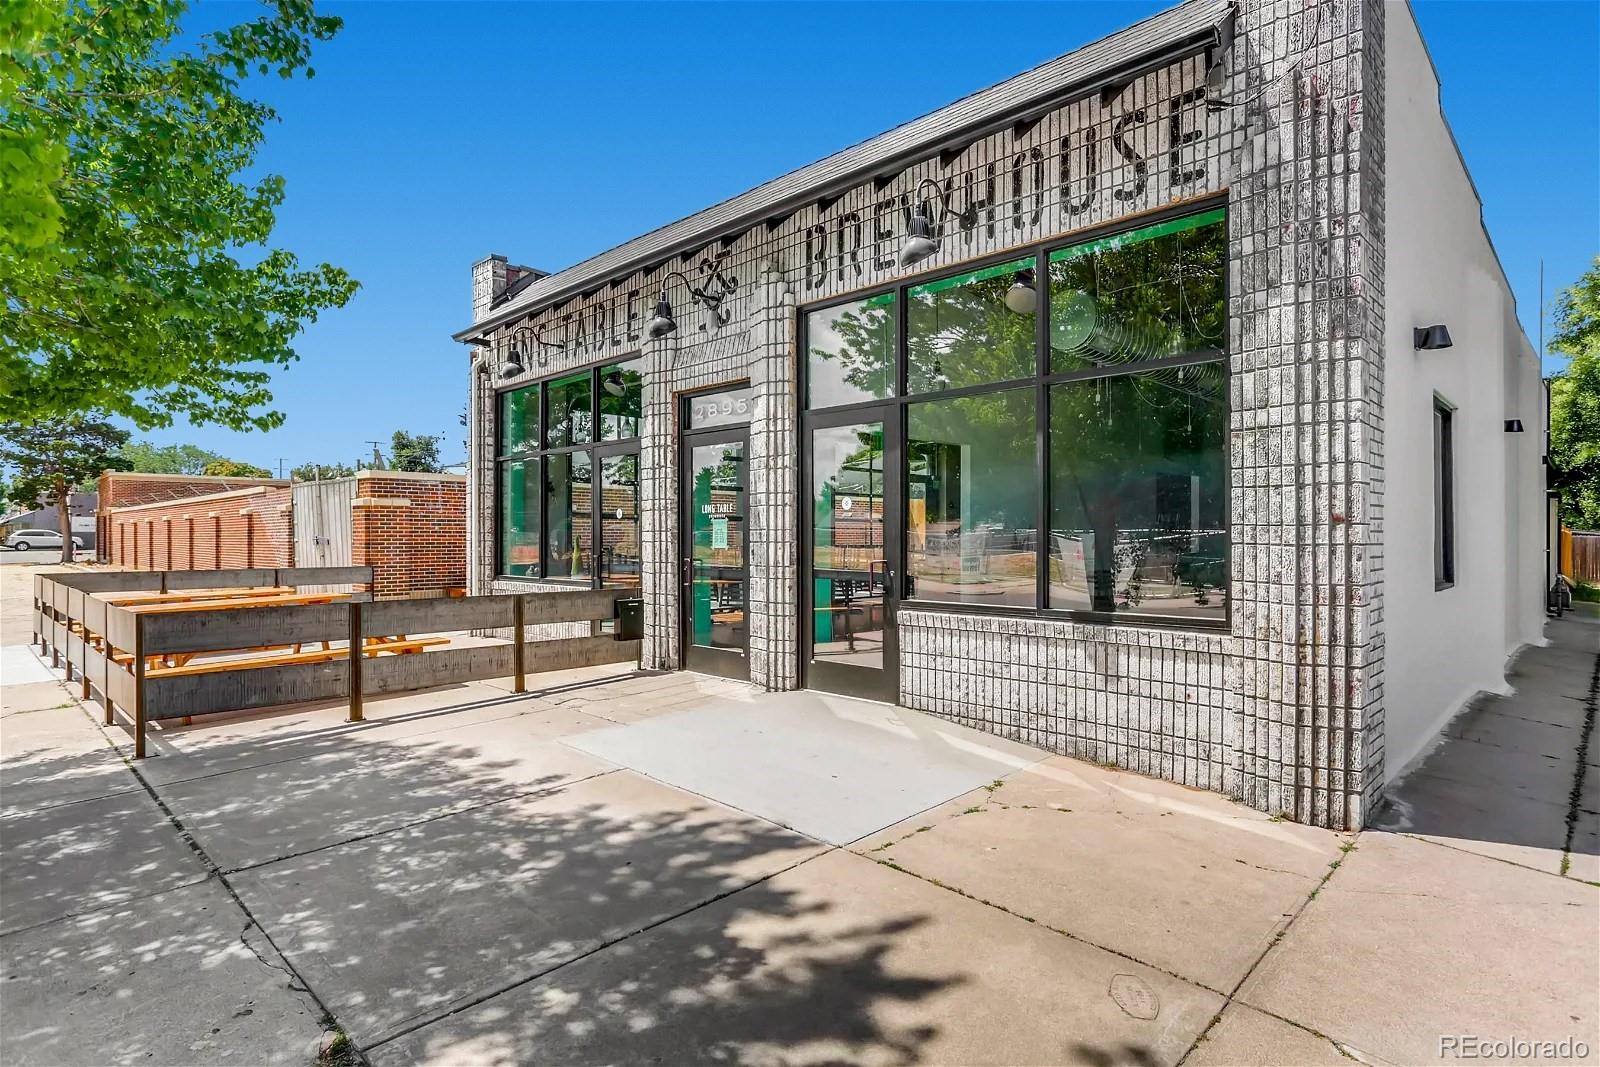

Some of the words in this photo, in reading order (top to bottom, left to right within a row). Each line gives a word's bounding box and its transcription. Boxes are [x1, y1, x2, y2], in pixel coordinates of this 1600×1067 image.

[496, 322, 549, 380] LNG
[561, 288, 640, 359] TABLE
[694, 398, 747, 420] 2895
[701, 504, 716, 514] LONG
[717, 503, 734, 513] TABLE
